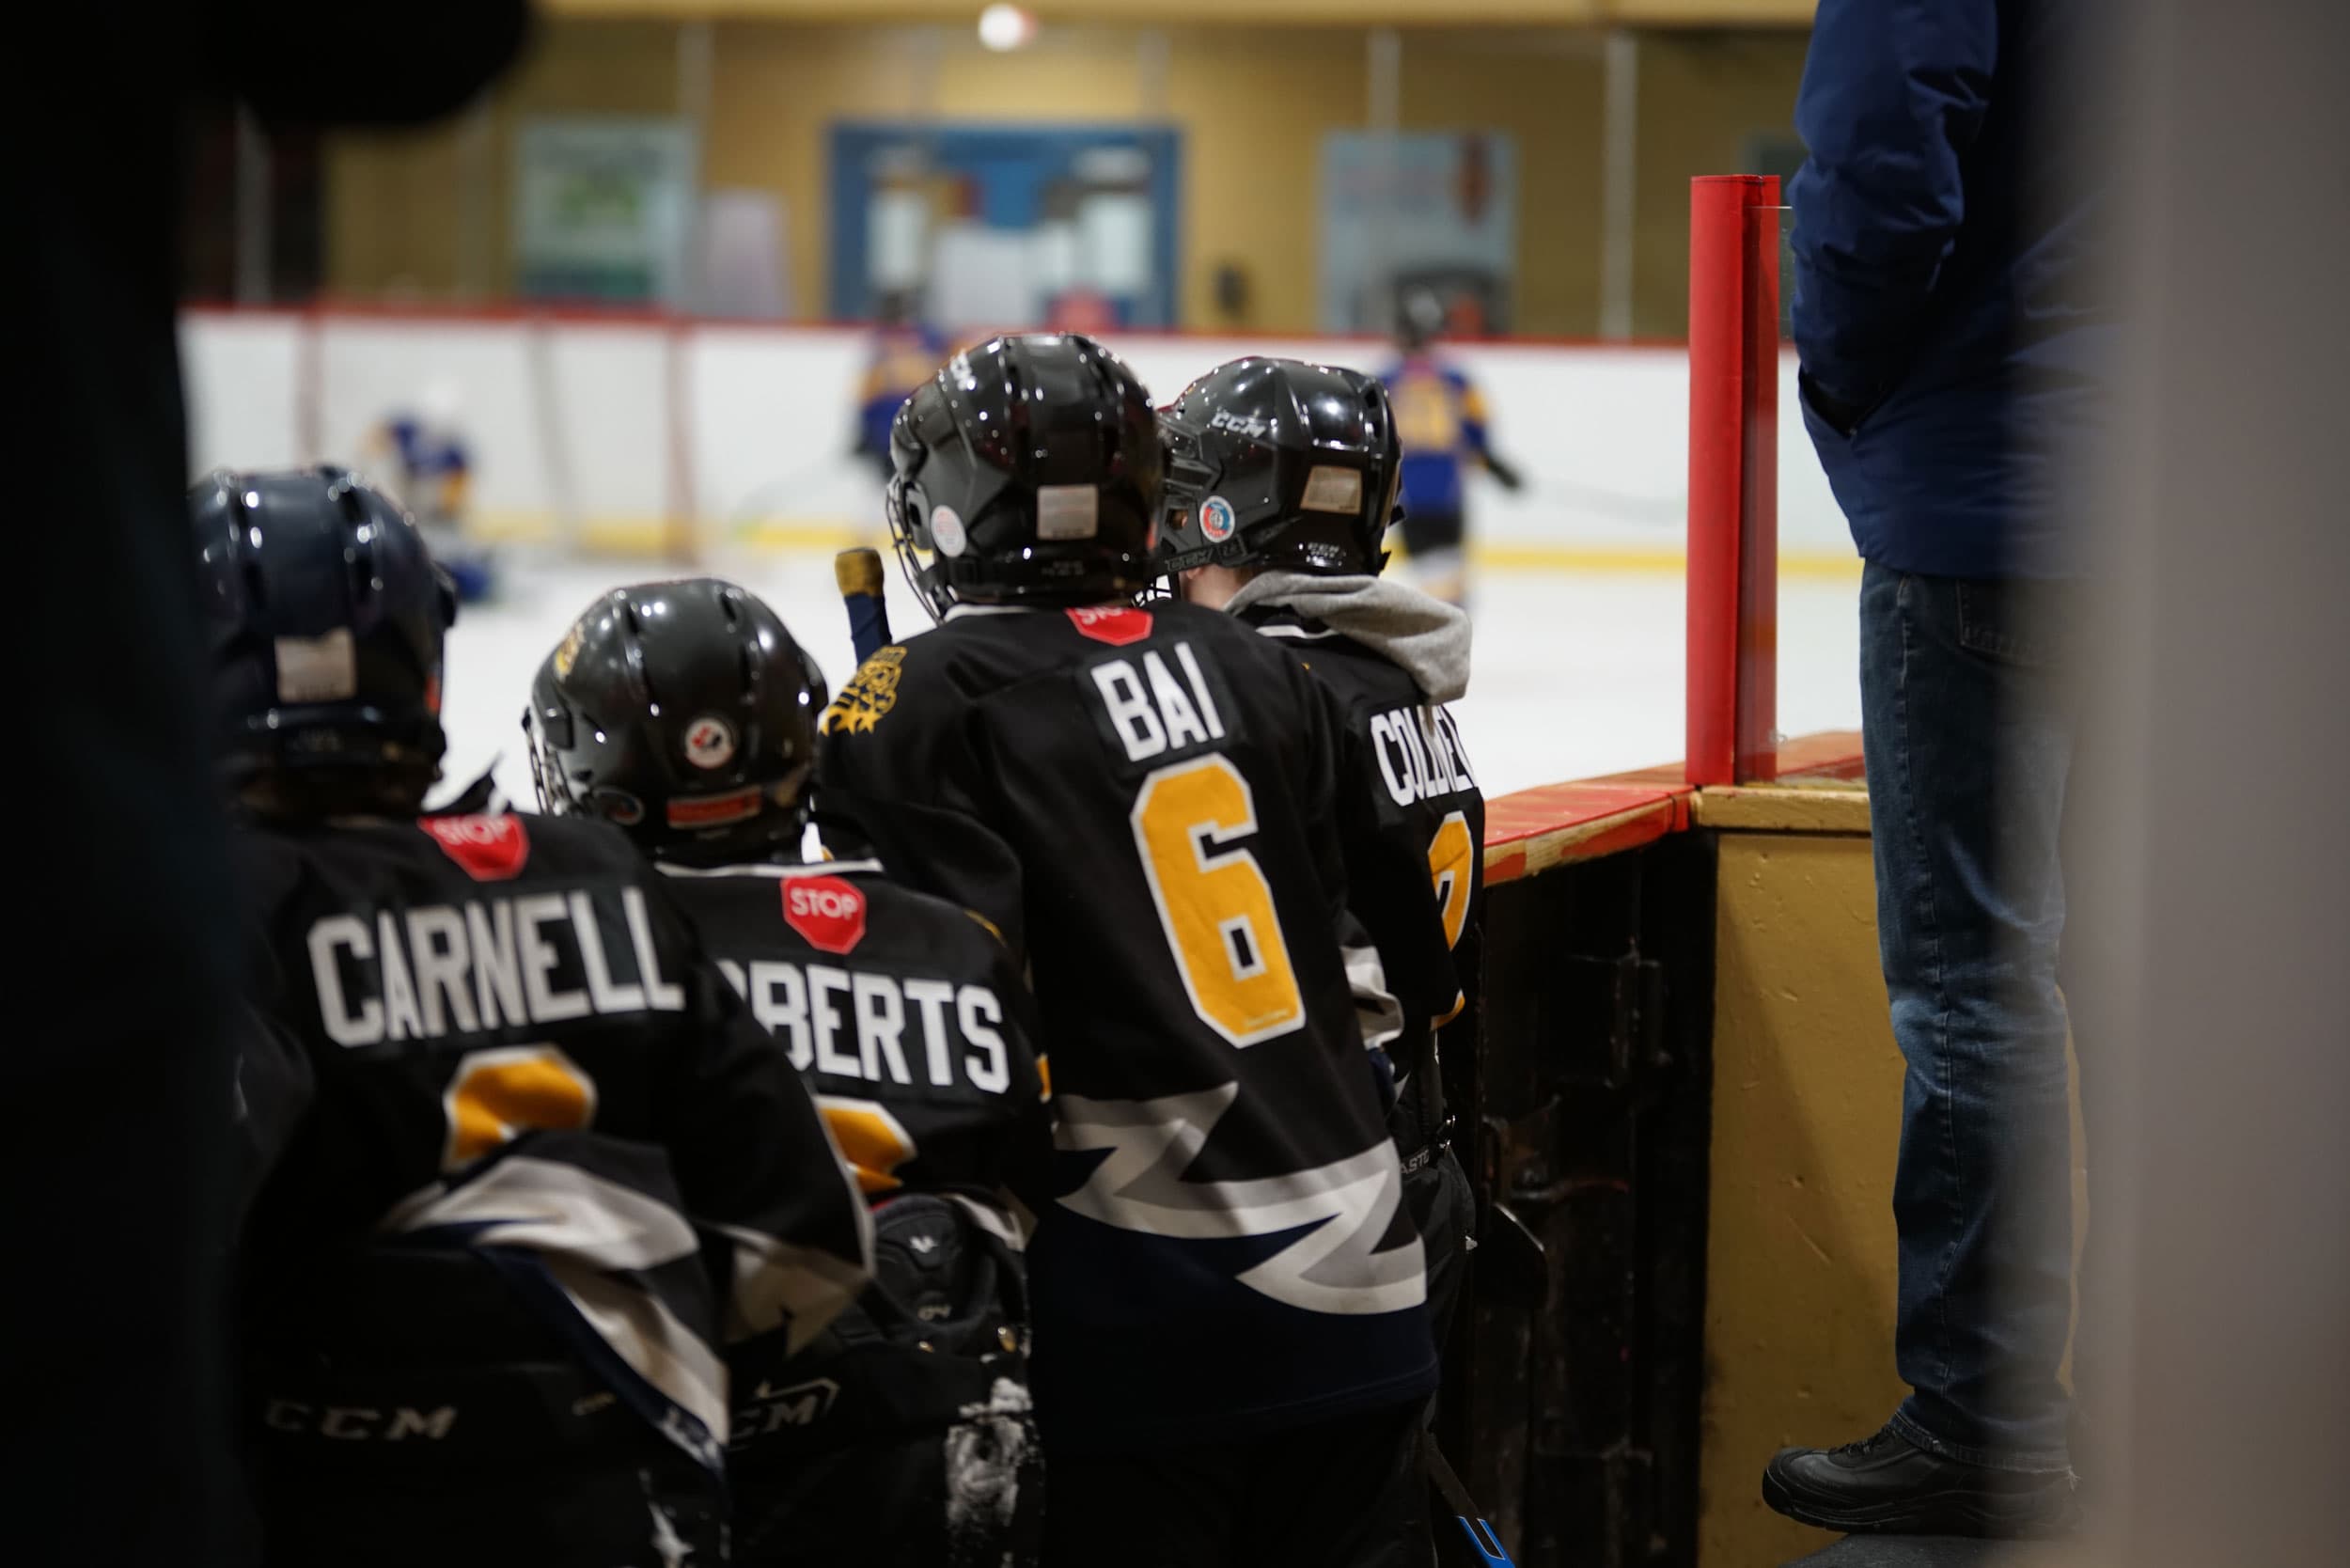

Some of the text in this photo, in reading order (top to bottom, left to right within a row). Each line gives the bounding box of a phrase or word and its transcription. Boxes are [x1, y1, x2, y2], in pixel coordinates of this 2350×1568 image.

[1090, 641, 1226, 762] BAI
[791, 886, 858, 920] STOP
[1131, 752, 1306, 1048] 6
[306, 886, 684, 1047] CARNELL
[715, 959, 1010, 1094] BERTS
[263, 1397, 460, 1442] CCM
